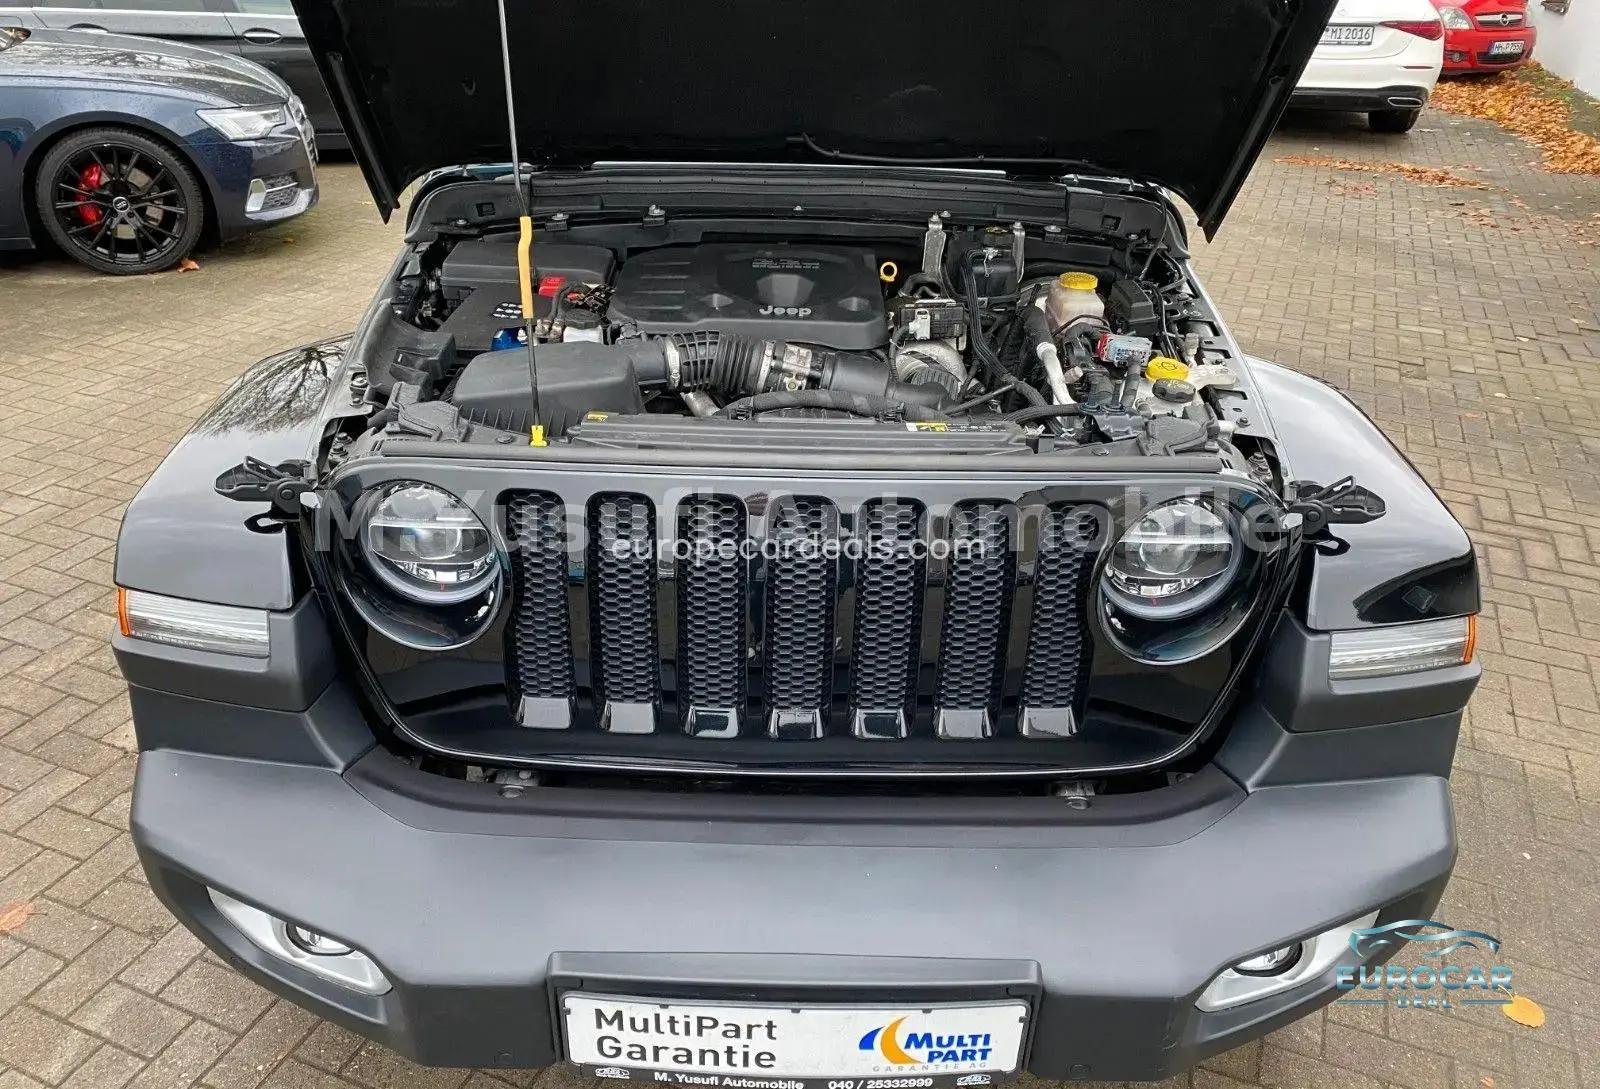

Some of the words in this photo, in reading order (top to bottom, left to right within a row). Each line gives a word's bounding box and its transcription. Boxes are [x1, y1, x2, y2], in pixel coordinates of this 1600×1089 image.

[1344, 27, 1371, 40] 2016
[759, 305, 812, 317] Jeep
[594, 1008, 777, 1041] MultiPart
[904, 1032, 991, 1049] MULTI
[596, 1035, 777, 1069] Garantie
[927, 1048, 992, 1063] PART
[872, 1063, 960, 1073] GARANTIE
[654, 1071, 672, 1082] M.
[674, 1073, 719, 1086] Yusufi
[721, 1076, 804, 1089] Automobile
[828, 1080, 854, 1089] 040
[866, 1077, 933, 1089] 25332999
